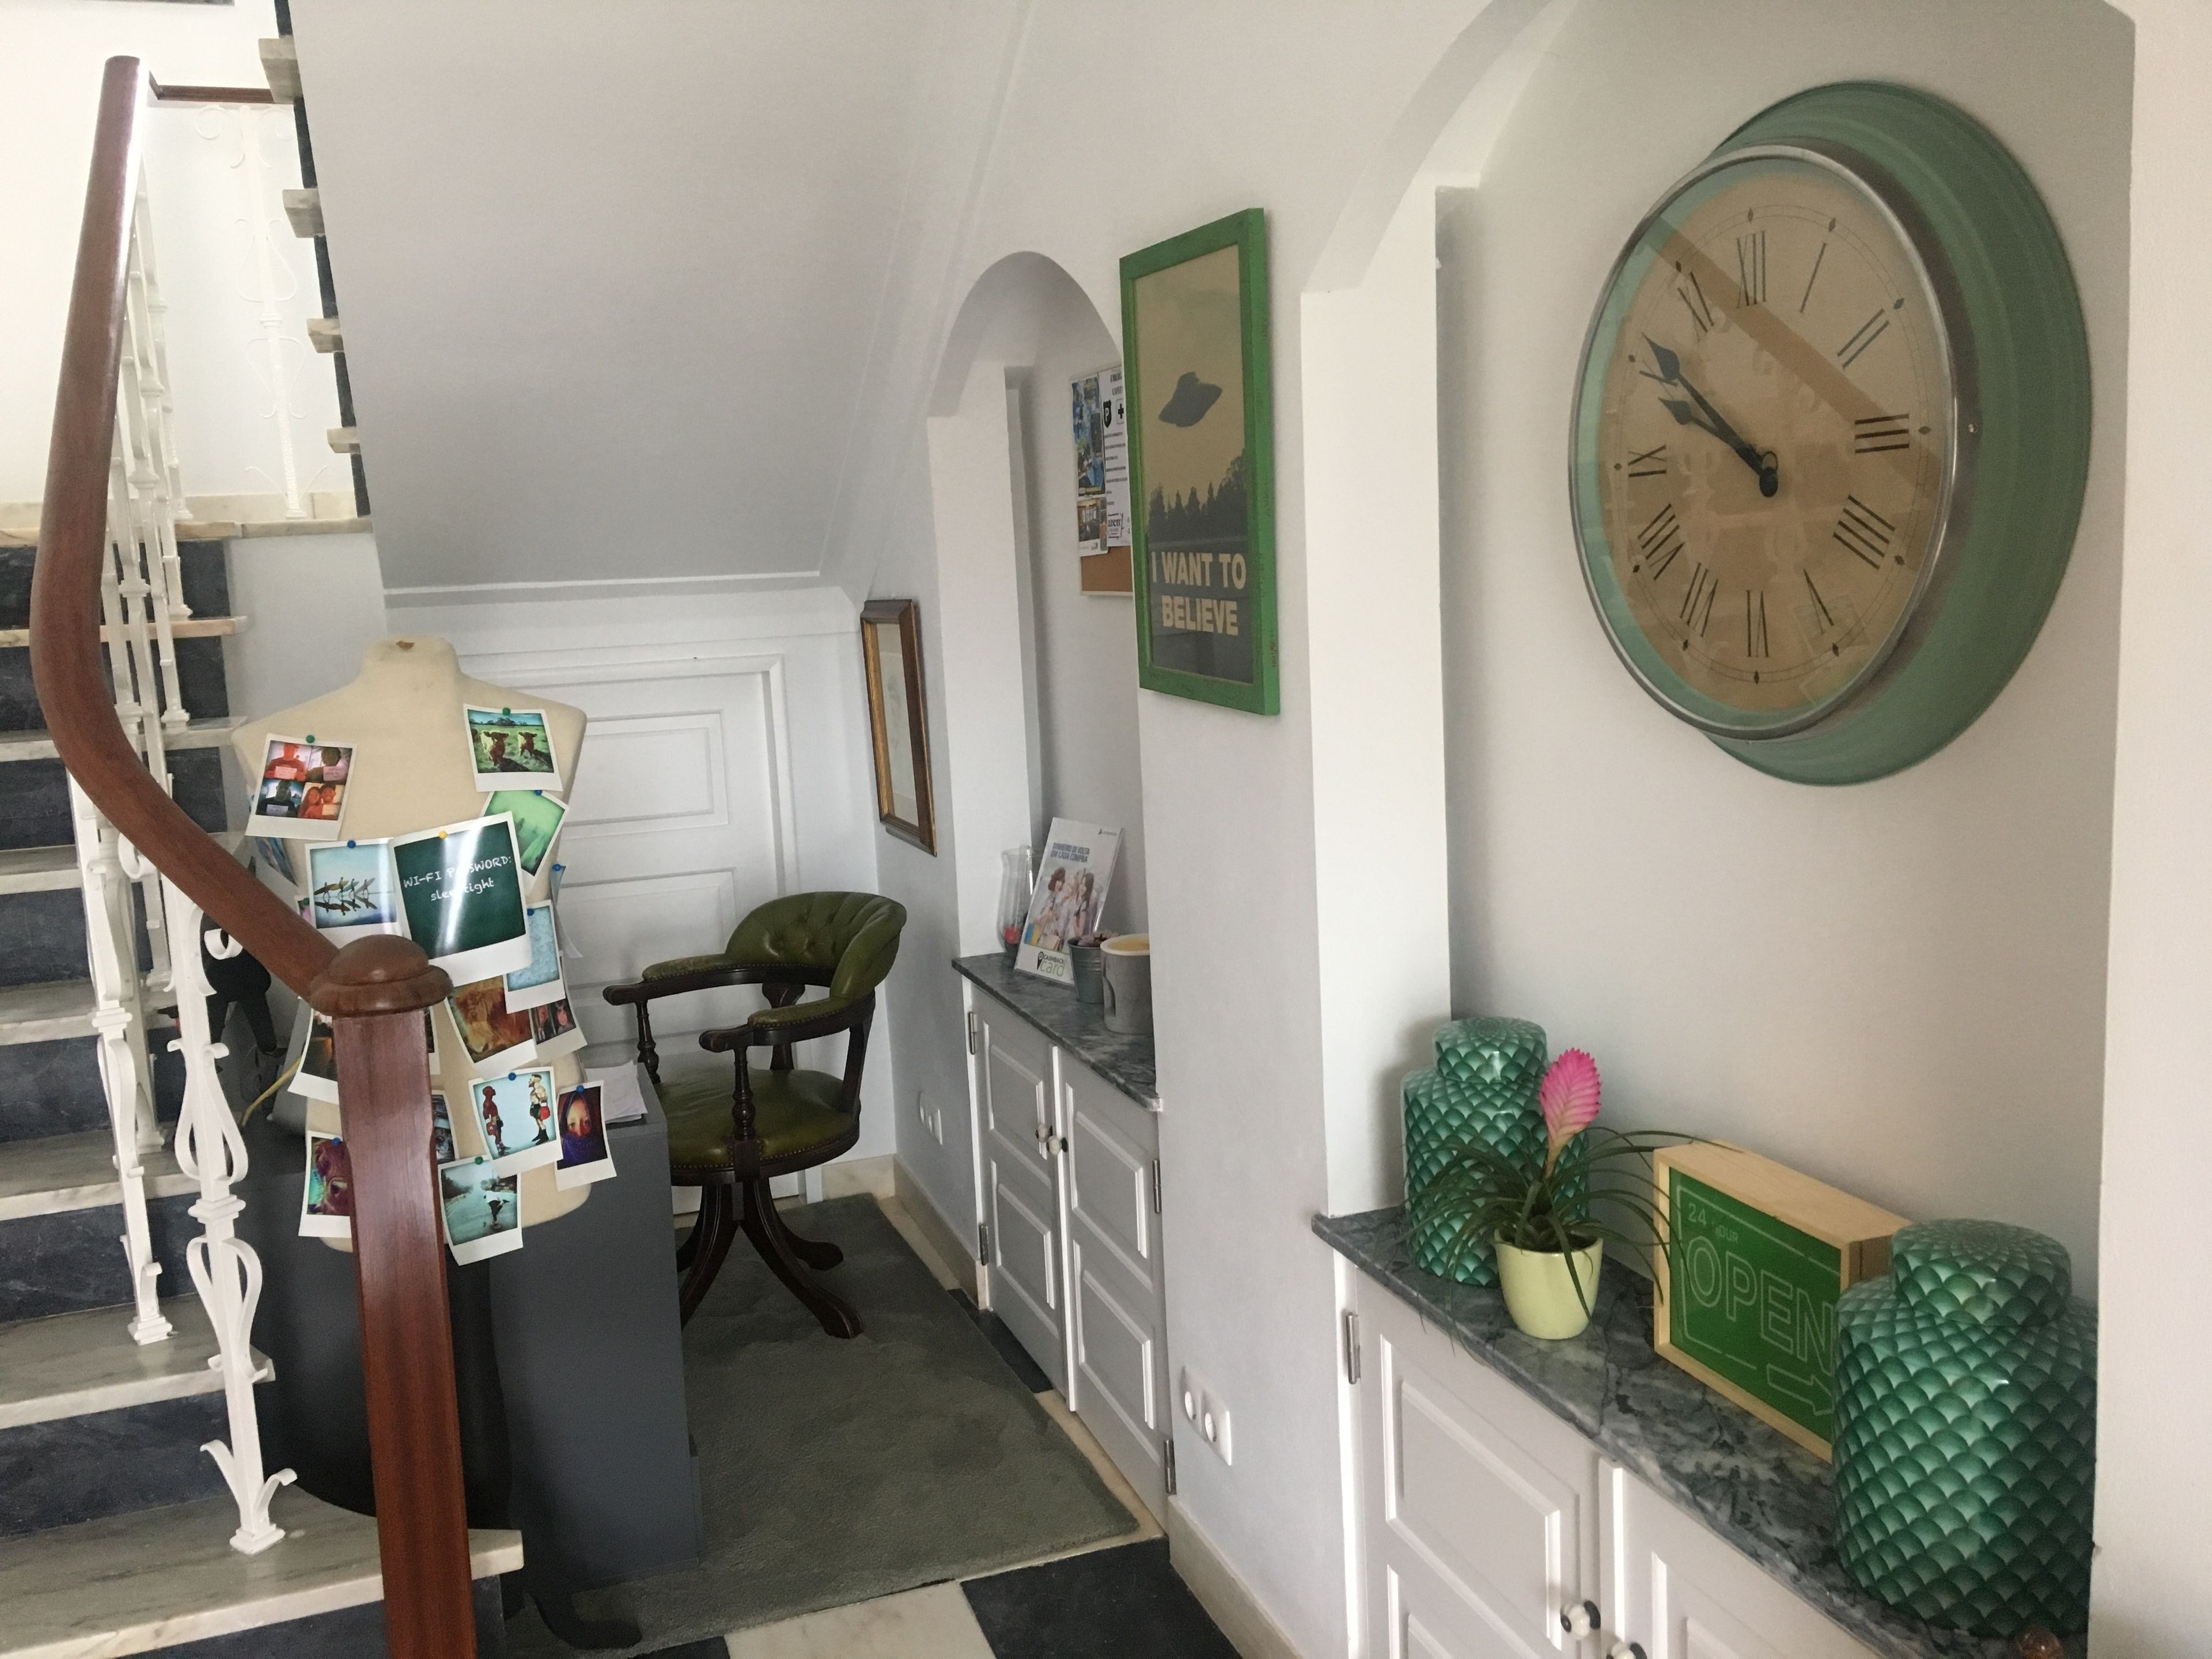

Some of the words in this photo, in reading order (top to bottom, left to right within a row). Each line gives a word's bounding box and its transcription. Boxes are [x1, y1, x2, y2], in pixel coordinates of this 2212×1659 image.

[1736, 230, 1766, 309] XII
[1800, 241, 1828, 313] I
[1677, 271, 1714, 343] XI
[1837, 308, 1890, 369] II
[1628, 445, 1668, 478] IX
[1854, 413, 1910, 454] III
[1637, 502, 1685, 582] VIII
[1833, 494, 1896, 571] IIII
[1152, 551, 1157, 583] I
[1161, 551, 1213, 586] WANT
[1219, 552, 1247, 590] TO
[1679, 562, 1719, 638] VII
[1803, 568, 1835, 636] V
[1161, 594, 1238, 636] BELIEVE
[1745, 589, 1769, 658] VI
[403, 871, 442, 888] WI-FI
[1688, 1202, 1707, 1227] 24
[1687, 1235, 1834, 1377] OPEN
